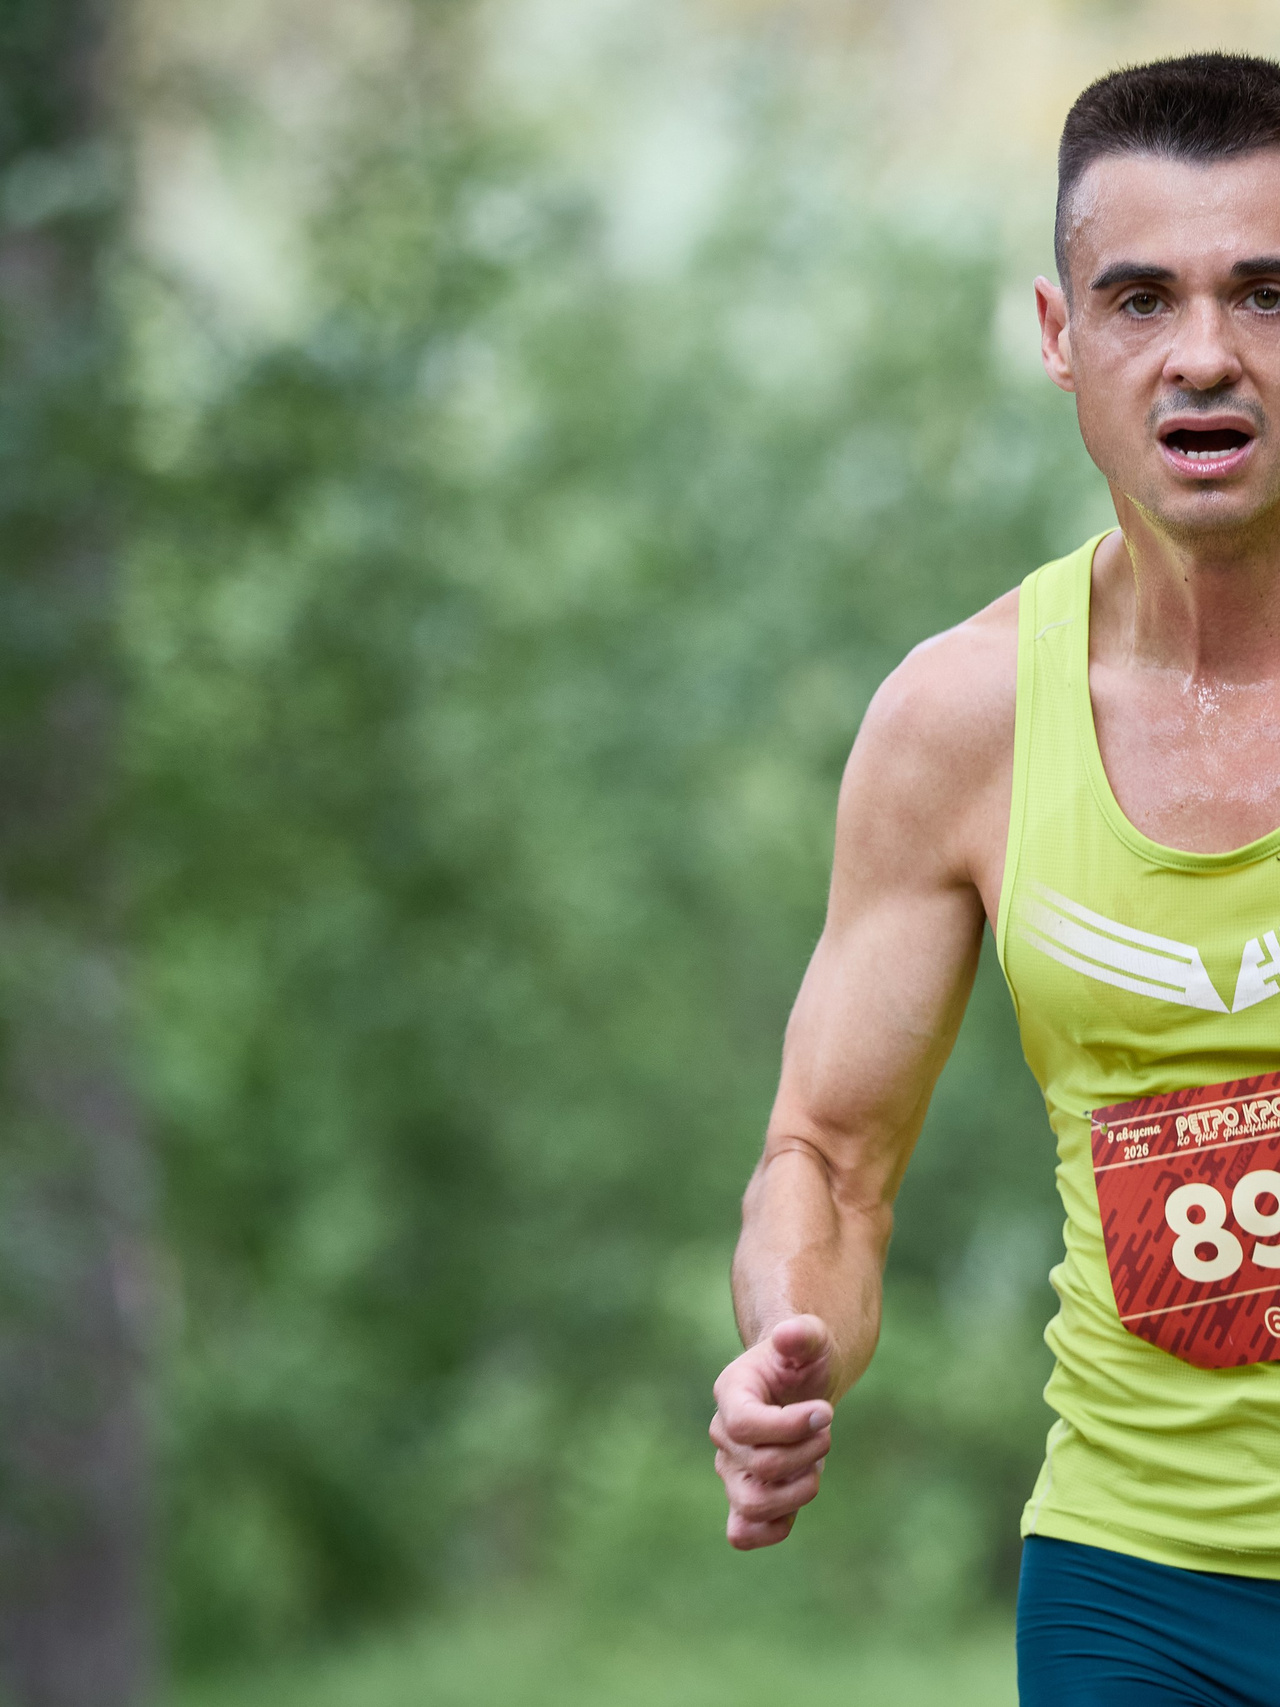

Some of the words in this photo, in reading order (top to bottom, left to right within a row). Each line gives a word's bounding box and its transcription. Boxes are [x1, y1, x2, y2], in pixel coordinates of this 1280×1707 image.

[1175, 1106, 1239, 1137] РЕТРО
[1107, 1130, 1114, 1144] 9
[1116, 1124, 1162, 1143] августа
[1176, 1135, 1190, 1147] ко
[1195, 1130, 1218, 1147] дню
[1123, 1142, 1149, 1160] 2026
